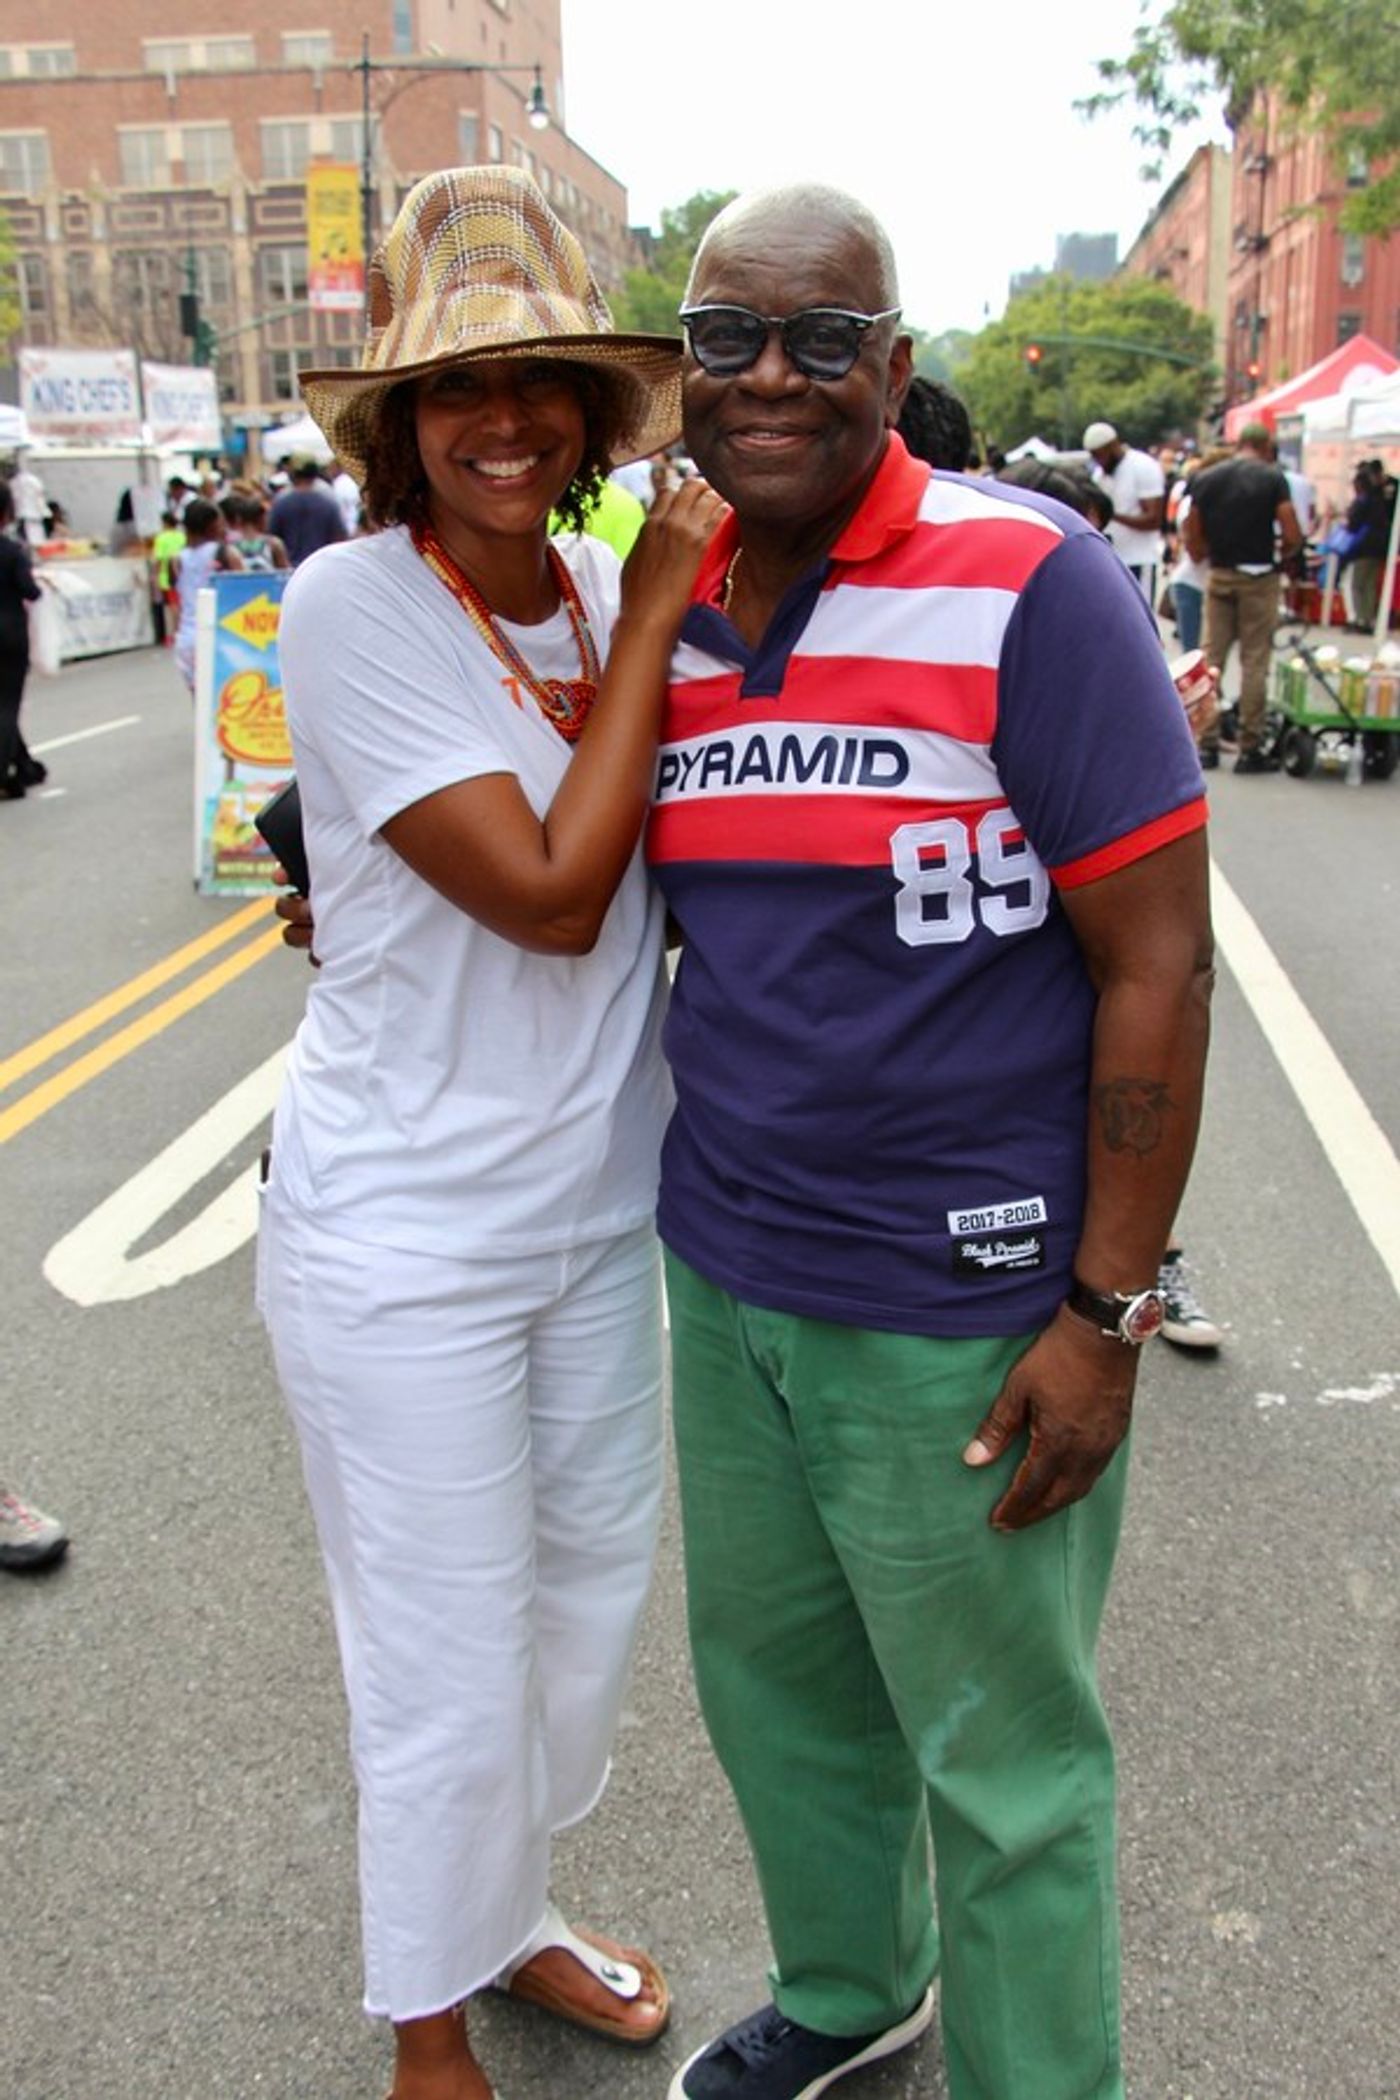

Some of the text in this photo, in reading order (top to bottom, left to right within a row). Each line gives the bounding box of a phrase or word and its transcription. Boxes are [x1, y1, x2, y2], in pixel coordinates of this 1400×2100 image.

[656, 734, 910, 799] PYRAMID
[889, 806, 1050, 947] 89
[957, 1203, 1040, 1231] 2017-2018
